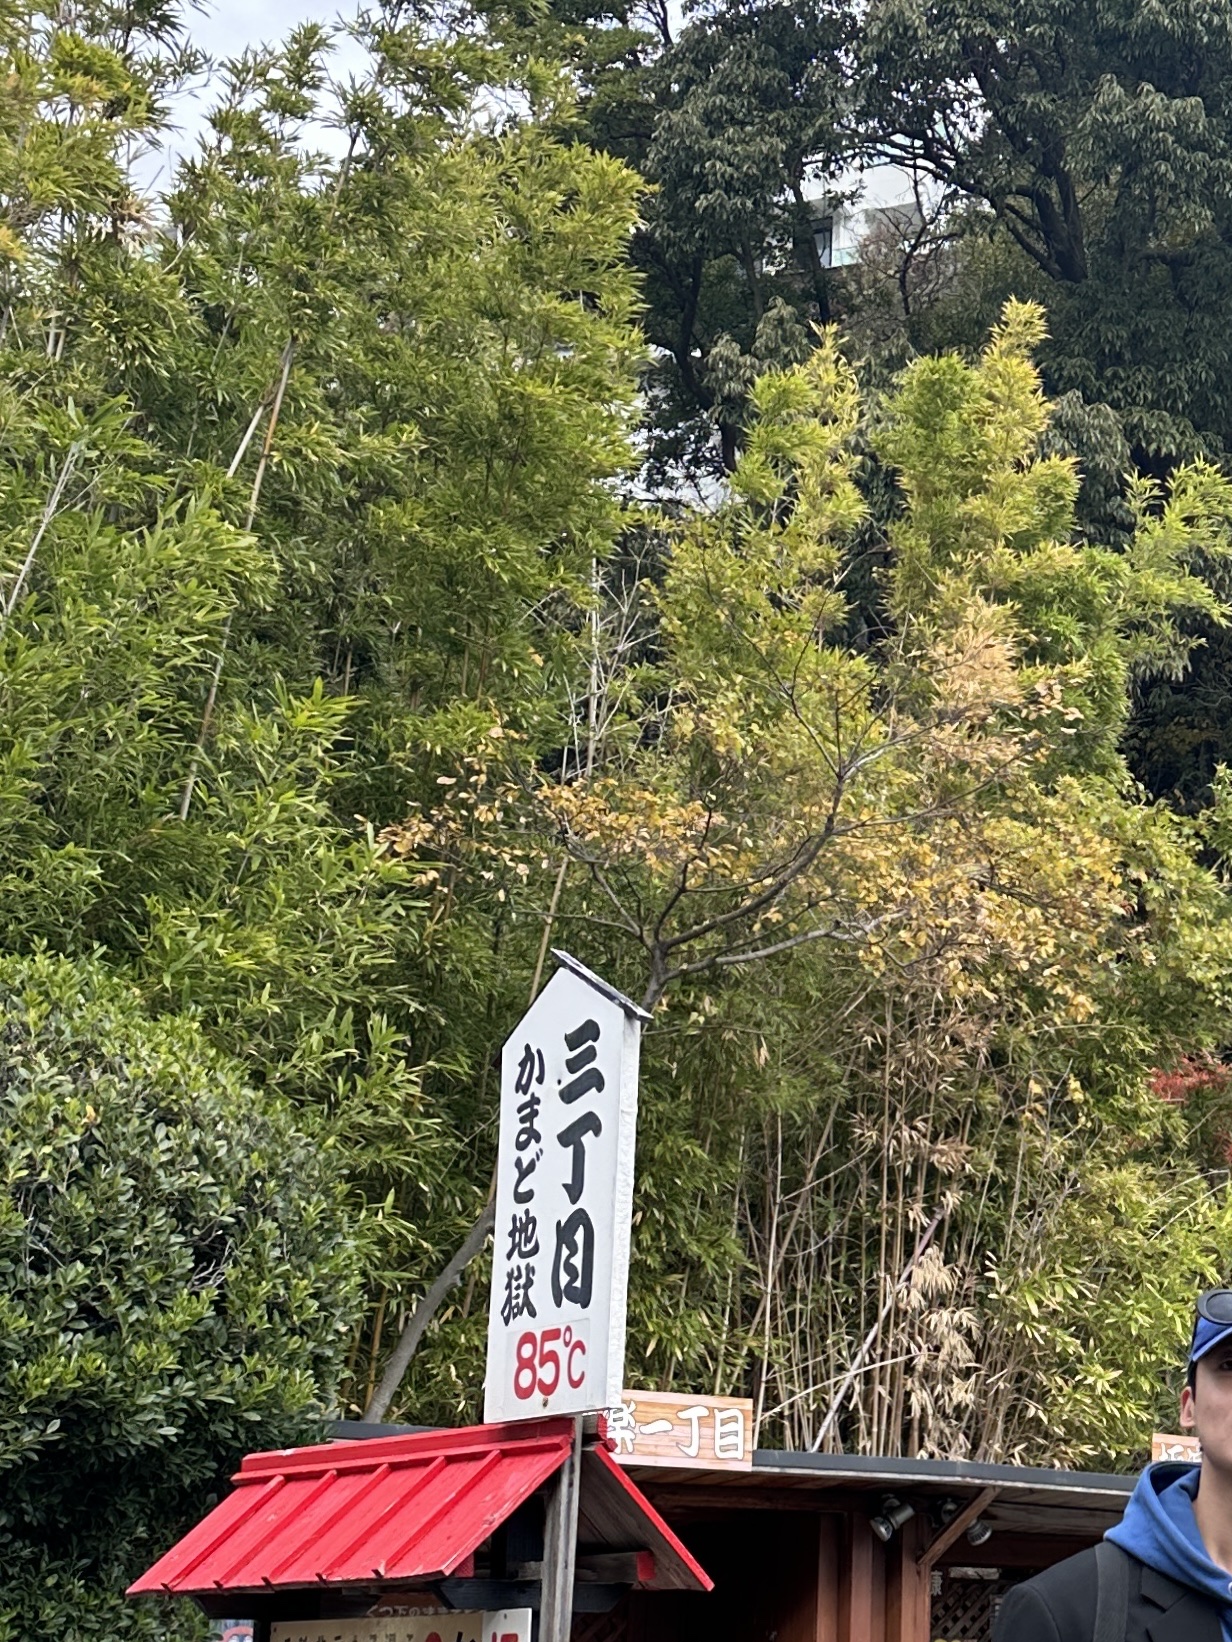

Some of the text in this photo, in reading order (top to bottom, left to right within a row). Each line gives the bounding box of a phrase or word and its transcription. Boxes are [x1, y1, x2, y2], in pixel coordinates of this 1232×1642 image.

[501, 1043, 545, 1327] かまど地獄
[551, 1019, 605, 1310] 三丁目
